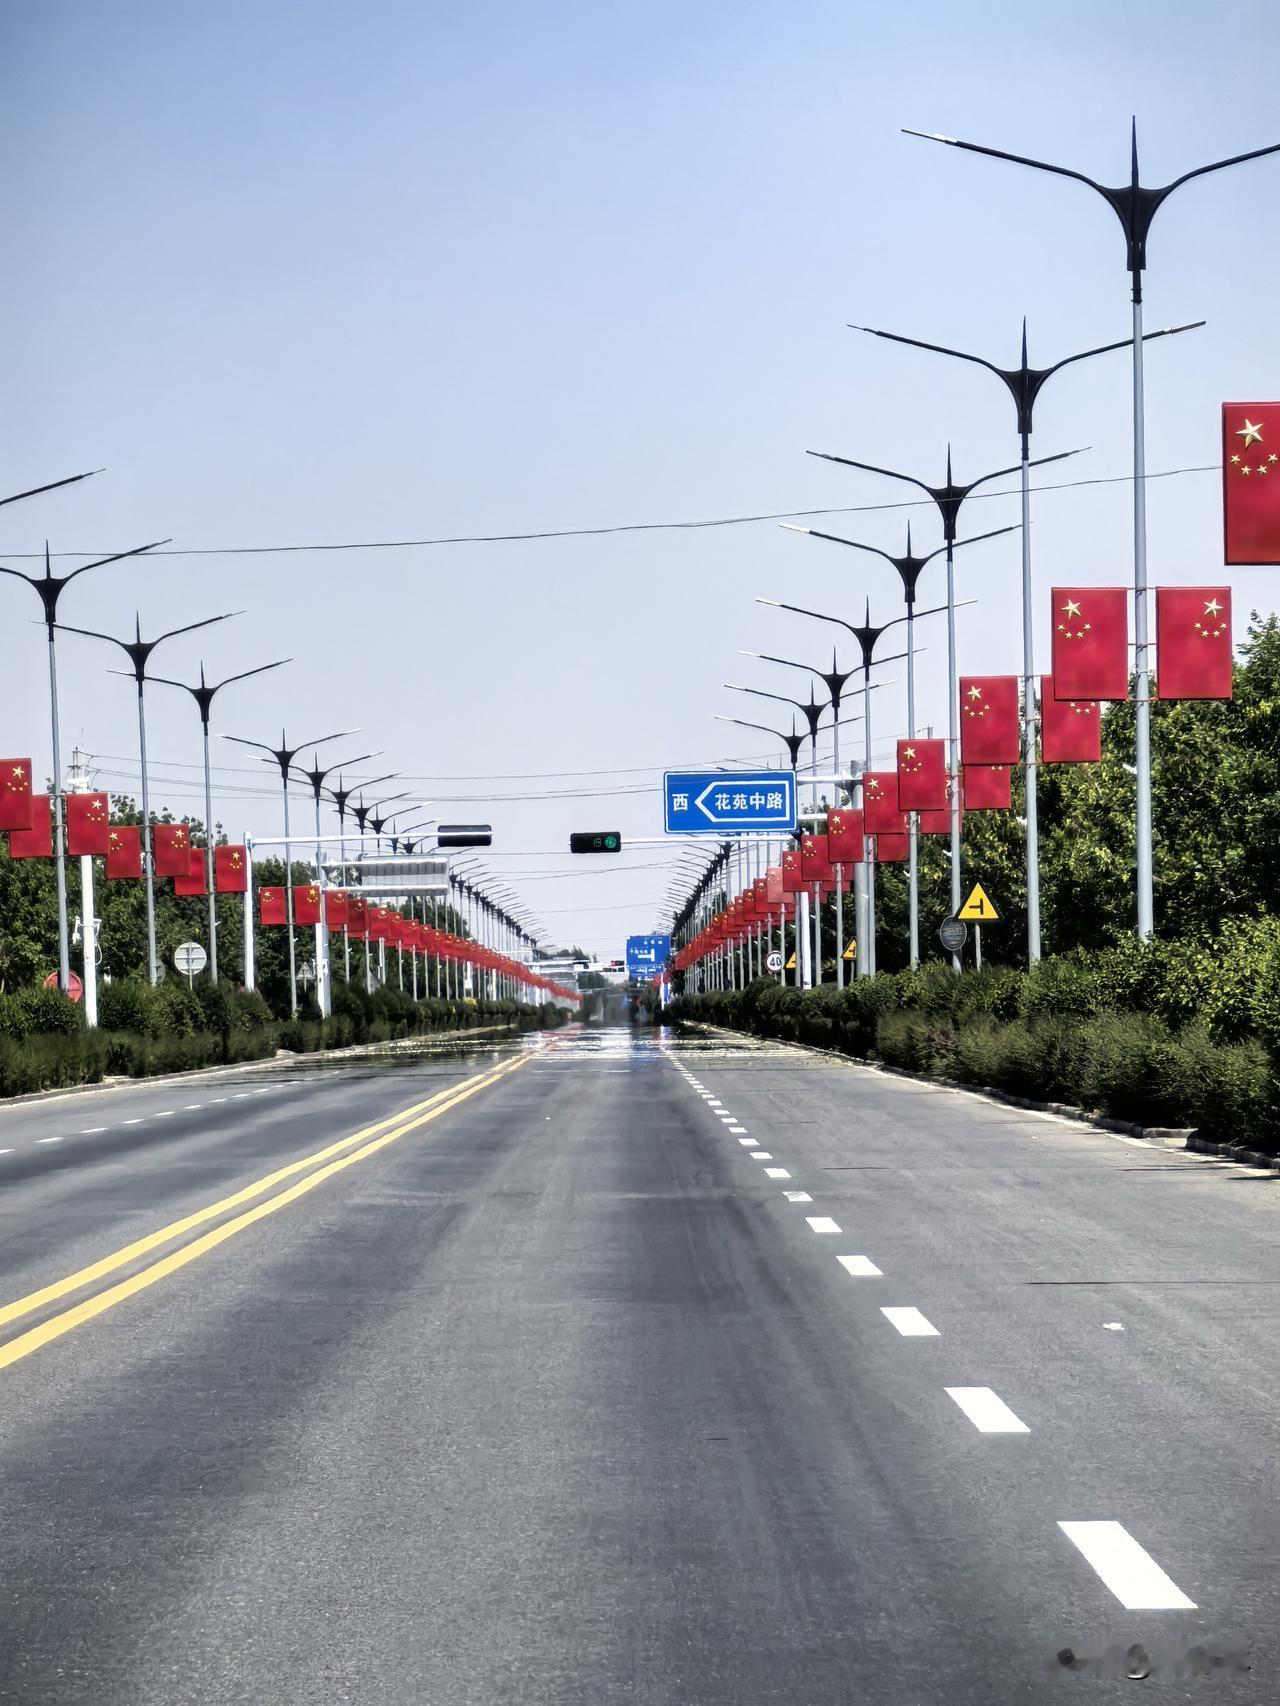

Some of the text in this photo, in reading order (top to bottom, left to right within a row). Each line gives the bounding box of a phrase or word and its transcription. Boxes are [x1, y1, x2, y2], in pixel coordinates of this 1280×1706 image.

[672, 792, 783, 811] 西 花苑中路
[770, 957, 782, 967] 40
